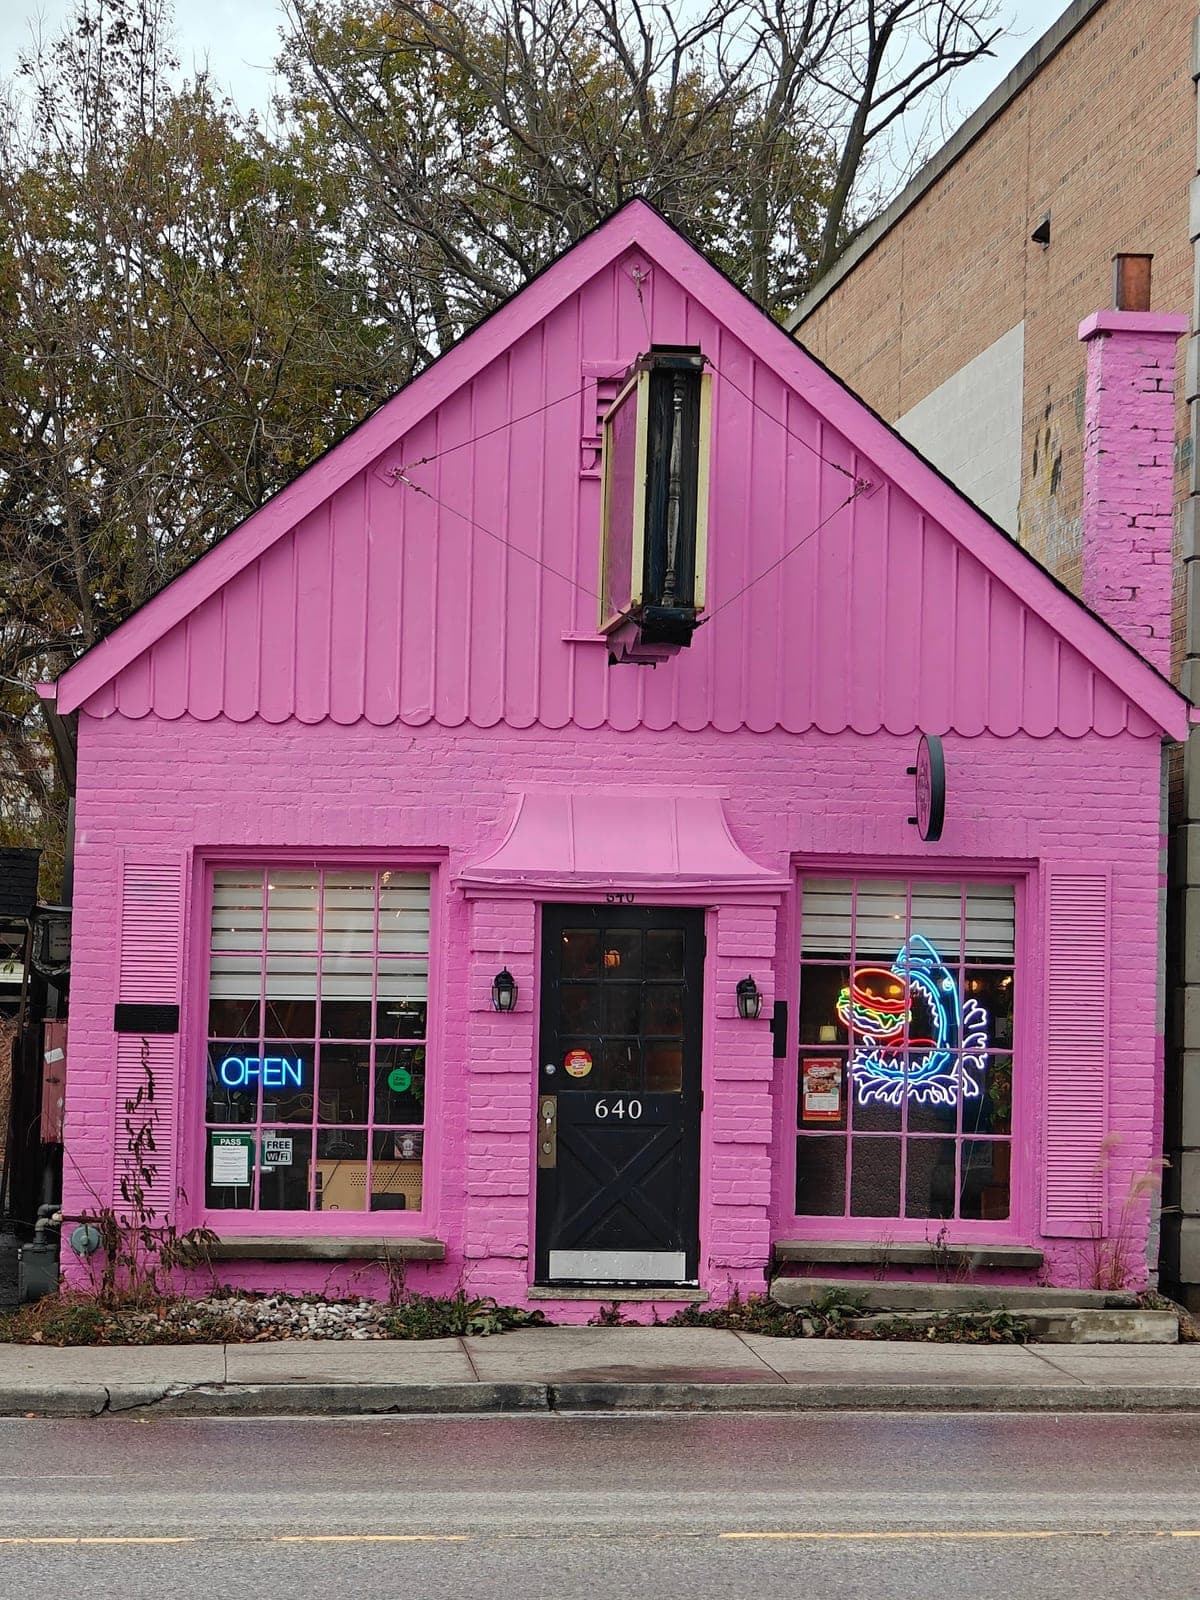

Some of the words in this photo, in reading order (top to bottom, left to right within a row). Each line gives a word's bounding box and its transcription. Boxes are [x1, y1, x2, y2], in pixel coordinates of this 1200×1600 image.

[221, 1057, 301, 1086] OPEN
[595, 1099, 642, 1119] 640
[220, 1138, 242, 1146] PASS
[266, 1141, 290, 1149] FREE
